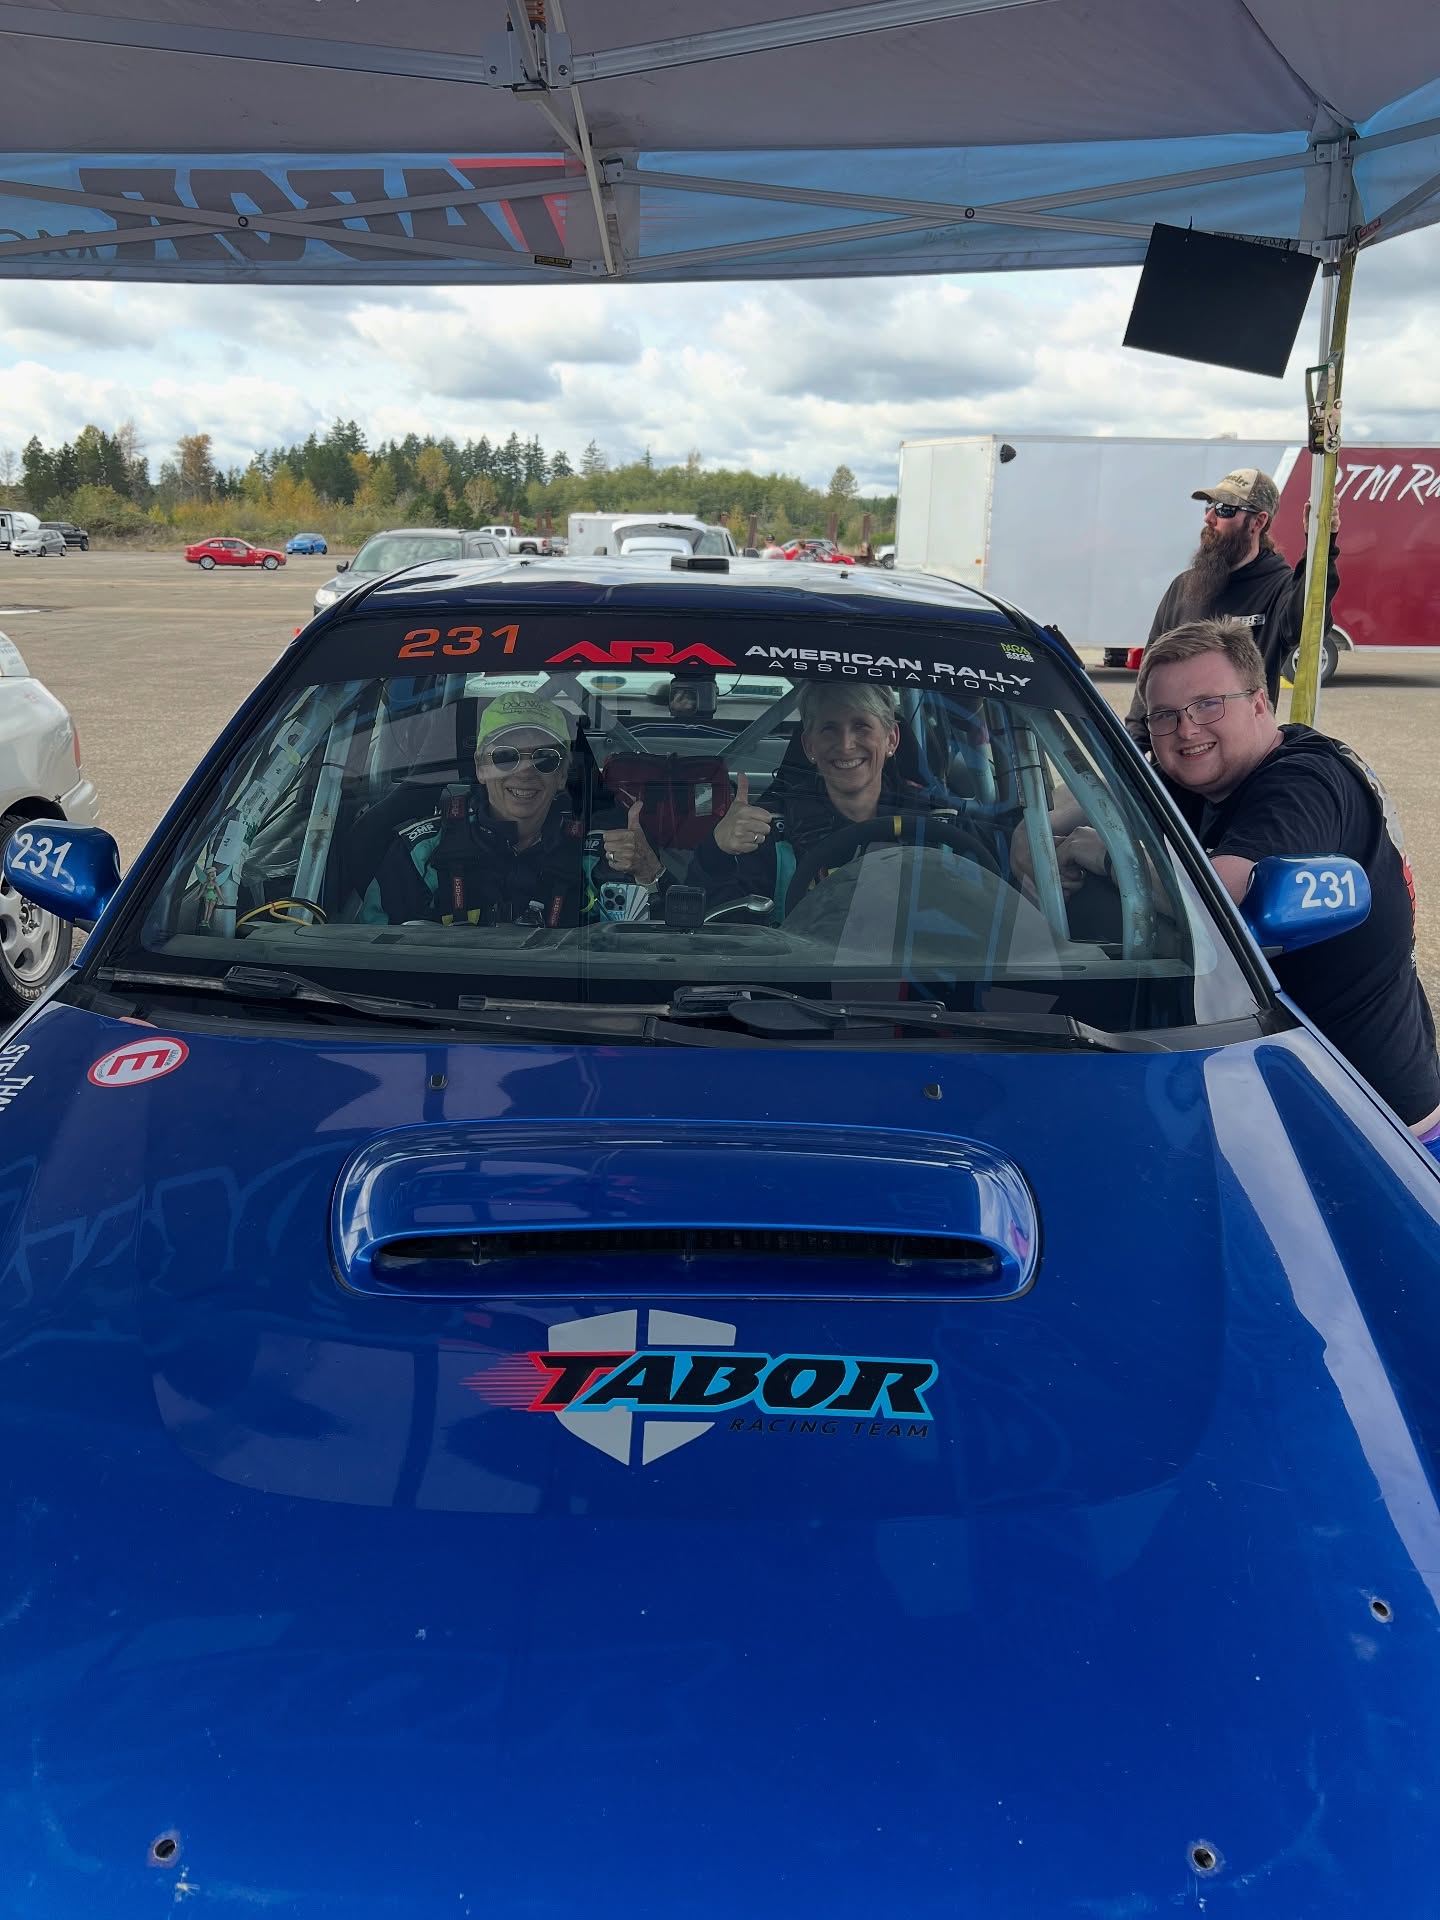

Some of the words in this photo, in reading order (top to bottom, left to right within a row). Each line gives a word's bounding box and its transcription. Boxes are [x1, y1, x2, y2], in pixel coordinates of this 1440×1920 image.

[398, 624, 520, 658] 231
[544, 640, 737, 667] ARA
[745, 645, 923, 671] AMERICAN
[933, 662, 1031, 687] RALLY
[10, 832, 73, 878] 231
[1295, 869, 1357, 909] 231
[528, 1351, 940, 1420] TABOR
[728, 1417, 839, 1435] RACING
[853, 1421, 929, 1438] TEAM
